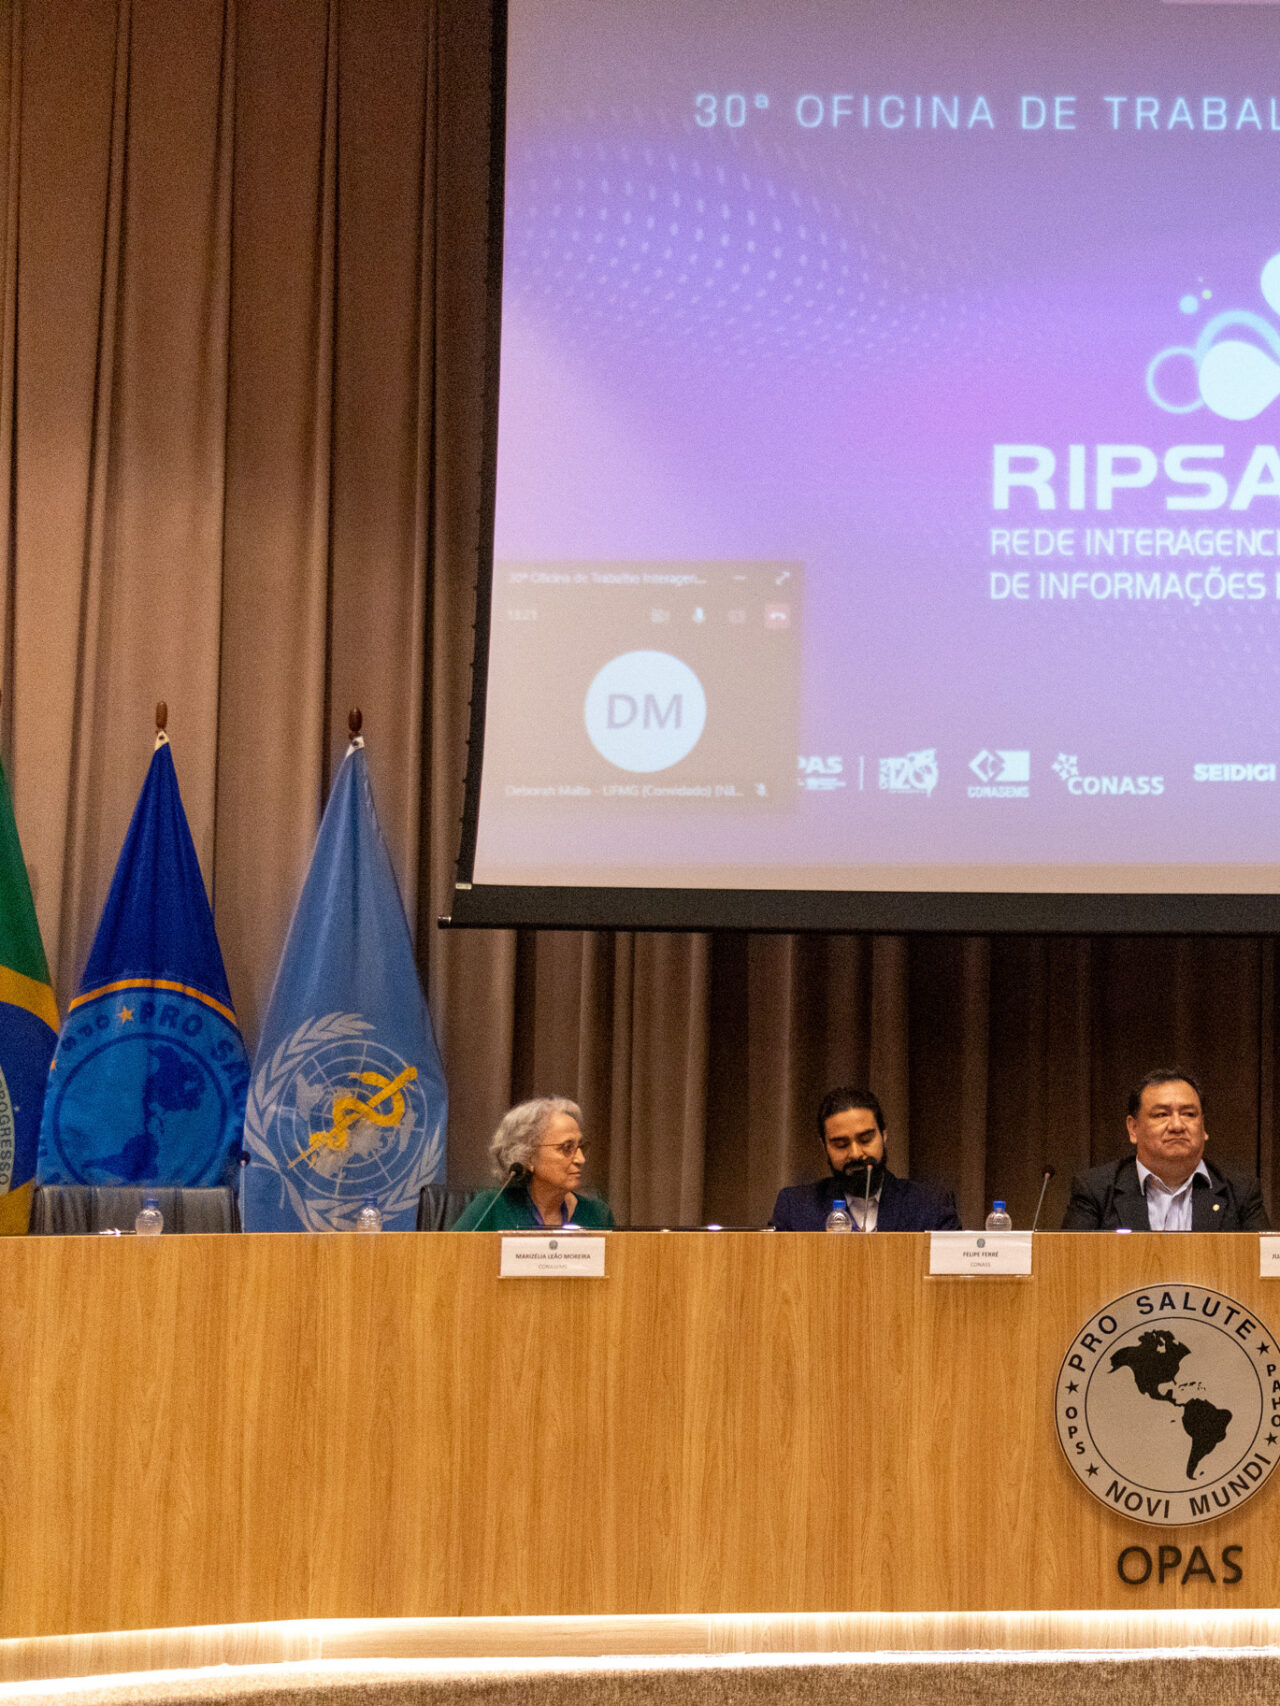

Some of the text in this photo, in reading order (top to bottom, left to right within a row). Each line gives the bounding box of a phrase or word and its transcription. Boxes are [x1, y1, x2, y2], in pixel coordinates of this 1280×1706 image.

[796, 94, 994, 129] OFICINA
[1021, 97, 1076, 129] DE
[990, 529, 1074, 556] REDE
[989, 573, 1029, 599] DE
[1040, 566, 1265, 606] INFORMAÇÕES
[606, 693, 683, 730] DM
[797, 755, 843, 774] PAS
[1194, 763, 1276, 782] SEIDIGI
[1067, 776, 1165, 795] CONASS
[139, 1001, 203, 1037] PRO
[0, 1080, 12, 1185] ROGRESSO
[1068, 1291, 1256, 1372] PRO SALUTE
[1065, 1406, 1086, 1455] OPS
[1105, 1453, 1271, 1518] NOVI MUNDI
[1117, 1545, 1243, 1585] OPAS
